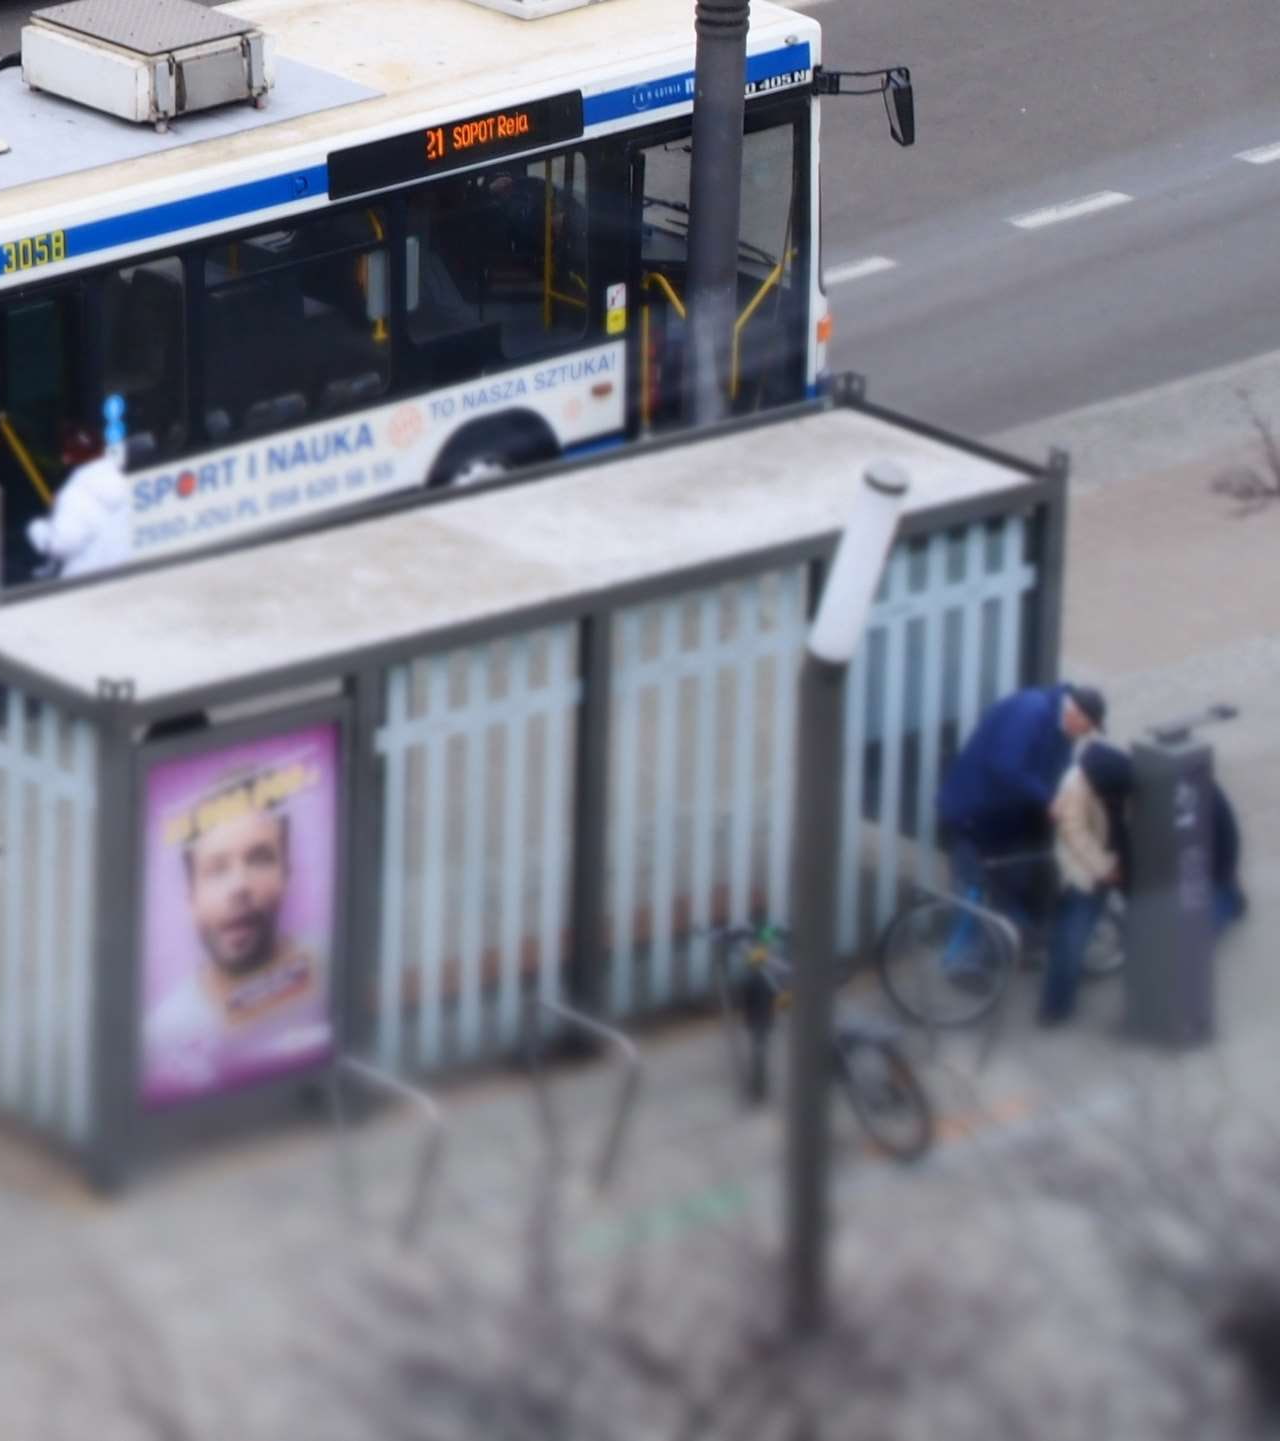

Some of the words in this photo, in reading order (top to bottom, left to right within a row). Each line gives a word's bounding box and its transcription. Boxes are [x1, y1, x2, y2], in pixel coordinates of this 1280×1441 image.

[758, 71, 793, 91] 405
[426, 127, 444, 160] 21
[452, 118, 495, 150] SOPOT
[497, 111, 529, 138] Reja
[2, 230, 65, 274] 3058
[430, 398, 456, 420] TO
[461, 378, 528, 410] NASZA
[133, 459, 237, 512] SPORT
[247, 453, 258, 480] I
[266, 422, 374, 474] NAUKA
